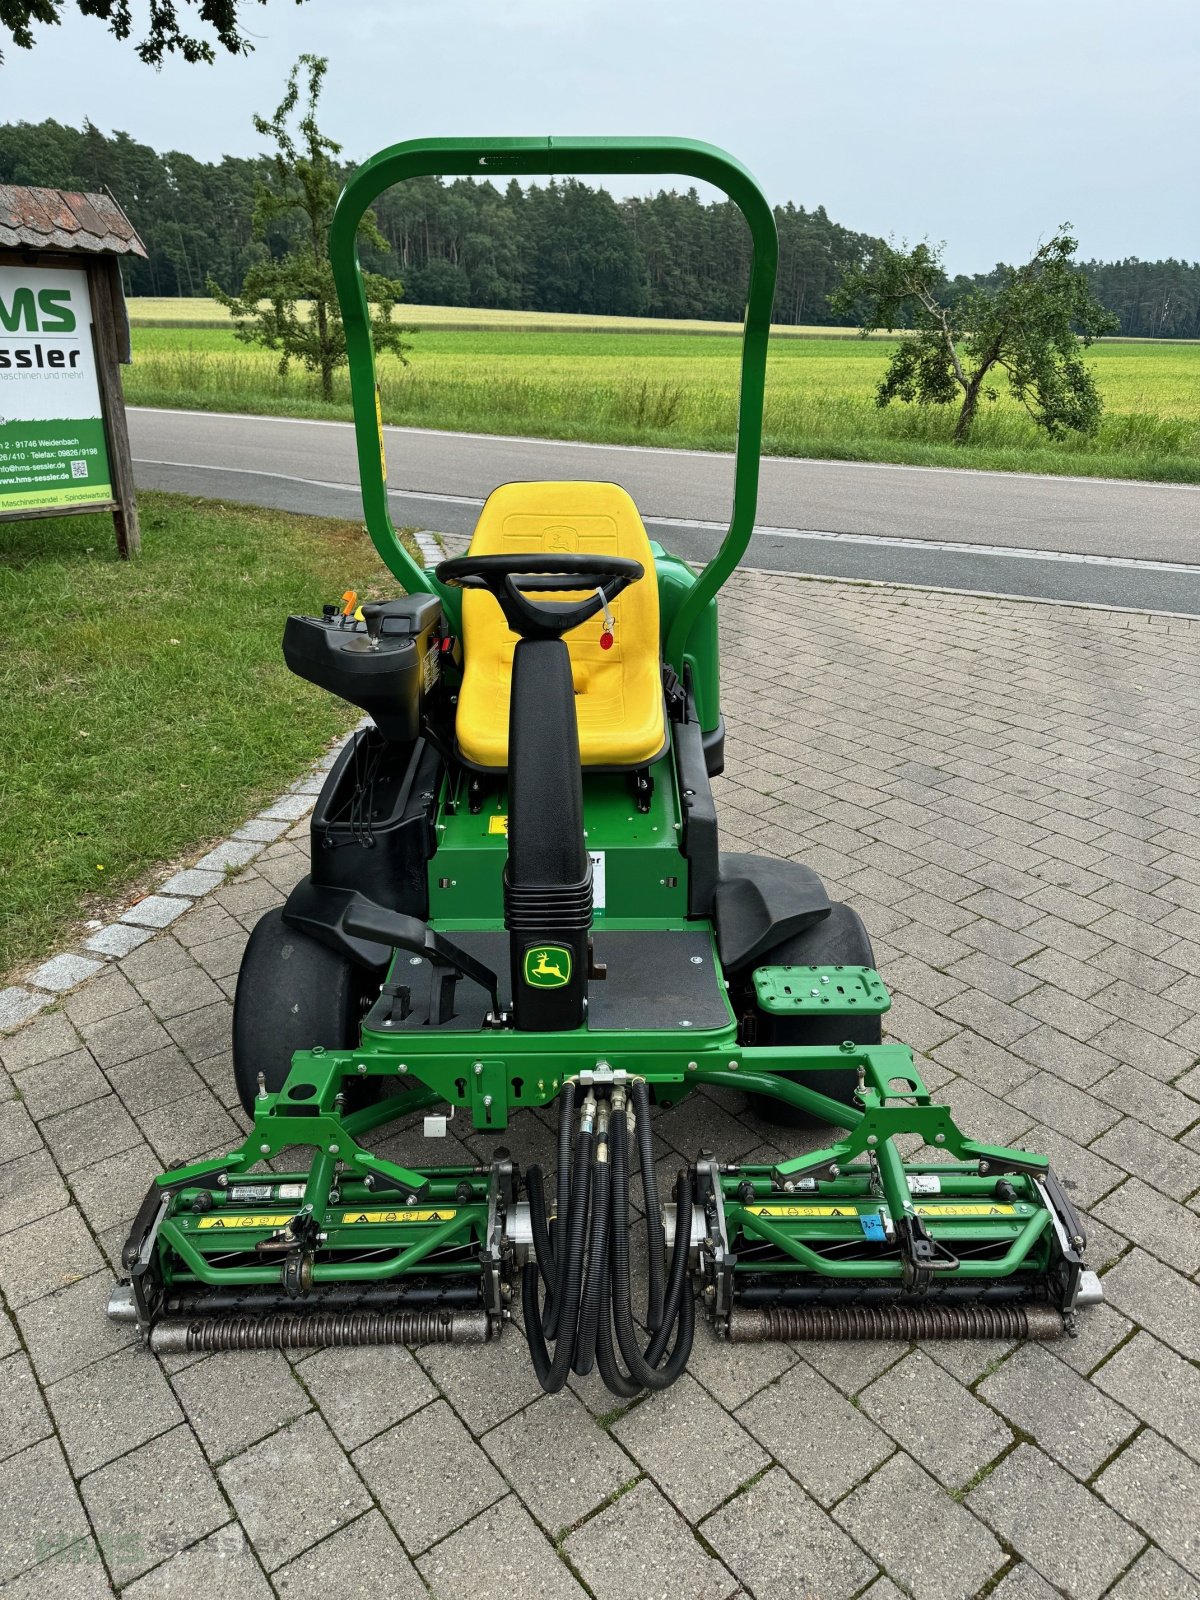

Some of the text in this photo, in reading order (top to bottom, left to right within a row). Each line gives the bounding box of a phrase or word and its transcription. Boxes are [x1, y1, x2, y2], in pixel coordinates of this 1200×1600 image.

[45, 371, 59, 380] und
[5, 441, 10, 449] 2
[15, 440, 37, 448] 91746
[38, 438, 79, 448] Weidenbach
[31, 451, 57, 460] Telefax:
[57, 448, 97, 456] 09826/9198
[1, 491, 110, 507] Maschinenhandel Spindelwartung
